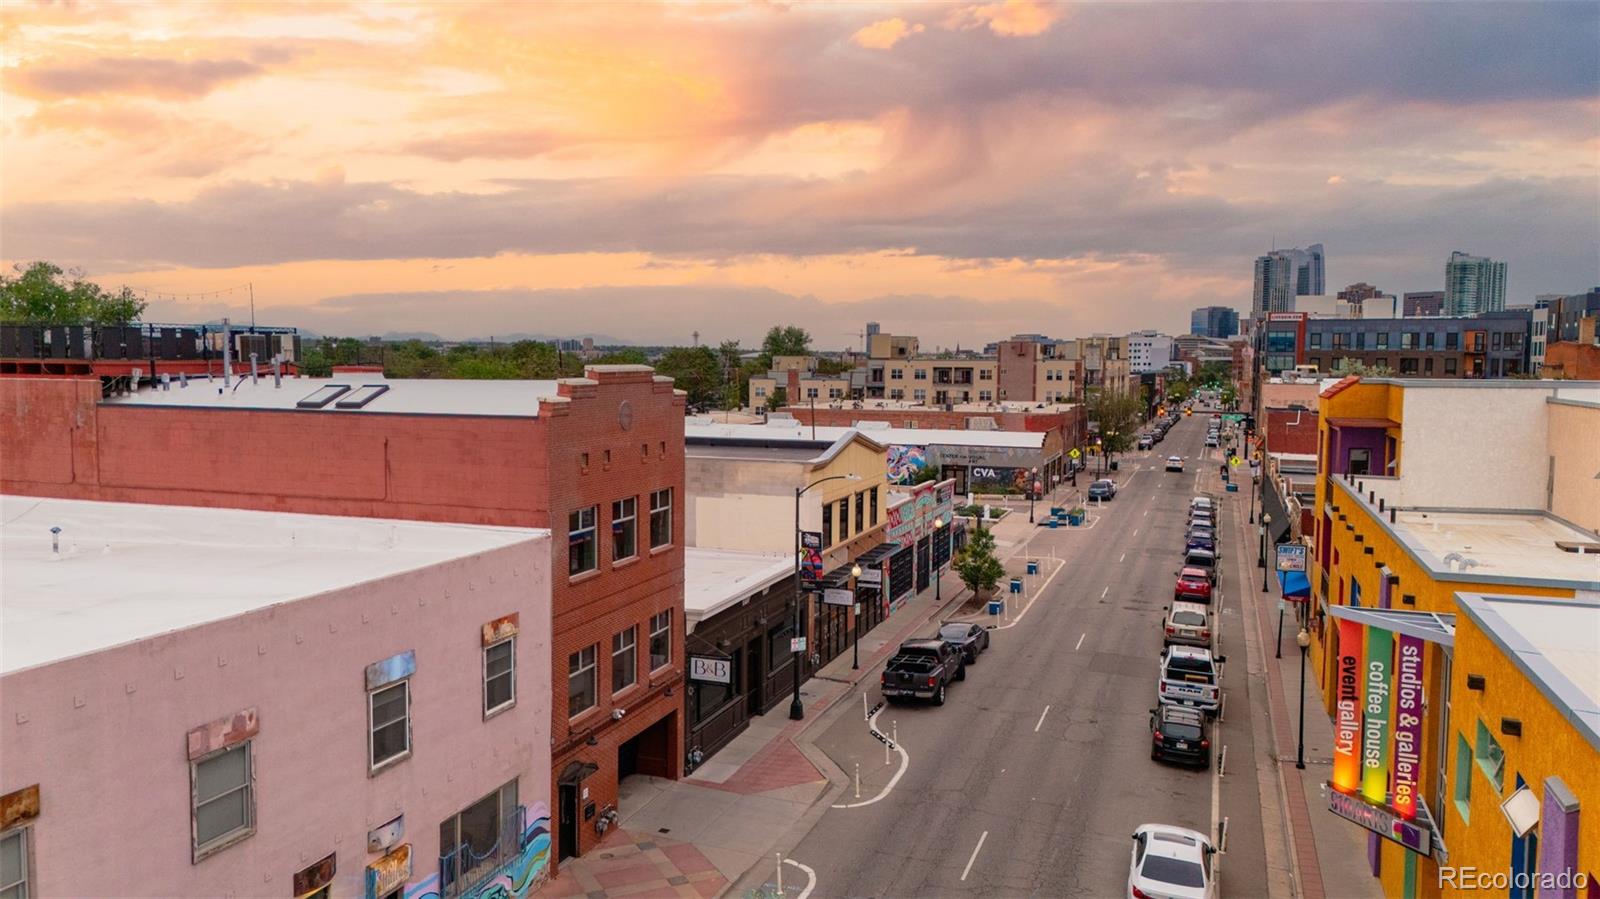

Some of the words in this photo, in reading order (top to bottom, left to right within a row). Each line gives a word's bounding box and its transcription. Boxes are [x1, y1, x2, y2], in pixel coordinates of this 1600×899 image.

[973, 467, 996, 477] CVA
[694, 659, 727, 678] B&B
[1367, 661, 1388, 714] coffee
[1400, 645, 1422, 709] studios
[1365, 718, 1387, 768] house
[1399, 713, 1419, 728] &
[1395, 731, 1418, 805] galleries
